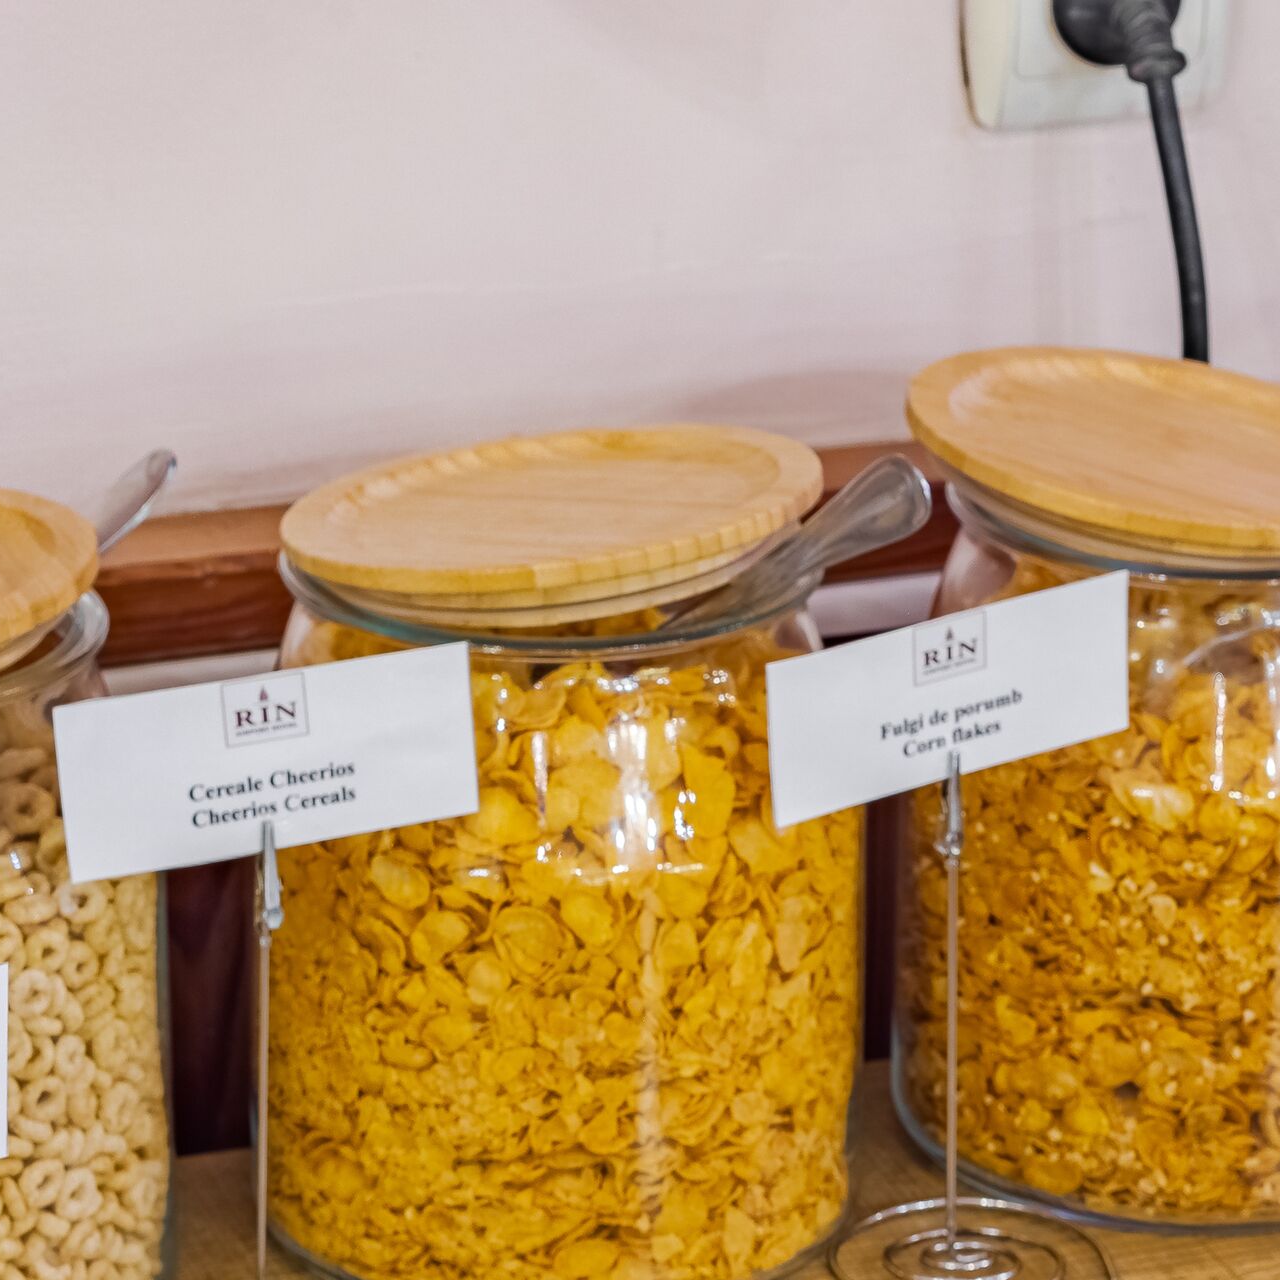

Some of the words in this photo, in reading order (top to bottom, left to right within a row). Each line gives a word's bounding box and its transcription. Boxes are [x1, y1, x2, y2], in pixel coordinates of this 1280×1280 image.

[923, 639, 977, 668] RIN
[235, 701, 298, 728] RIN
[880, 715, 923, 741] Fulgi
[930, 708, 949, 727] de
[955, 689, 1022, 722] porumb
[903, 735, 946, 758] Corn
[953, 720, 1002, 746] flakes
[189, 777, 265, 802] Cereale
[270, 762, 355, 788] Cheerios
[193, 801, 277, 828] Cheerios
[285, 787, 356, 812] Cereals
